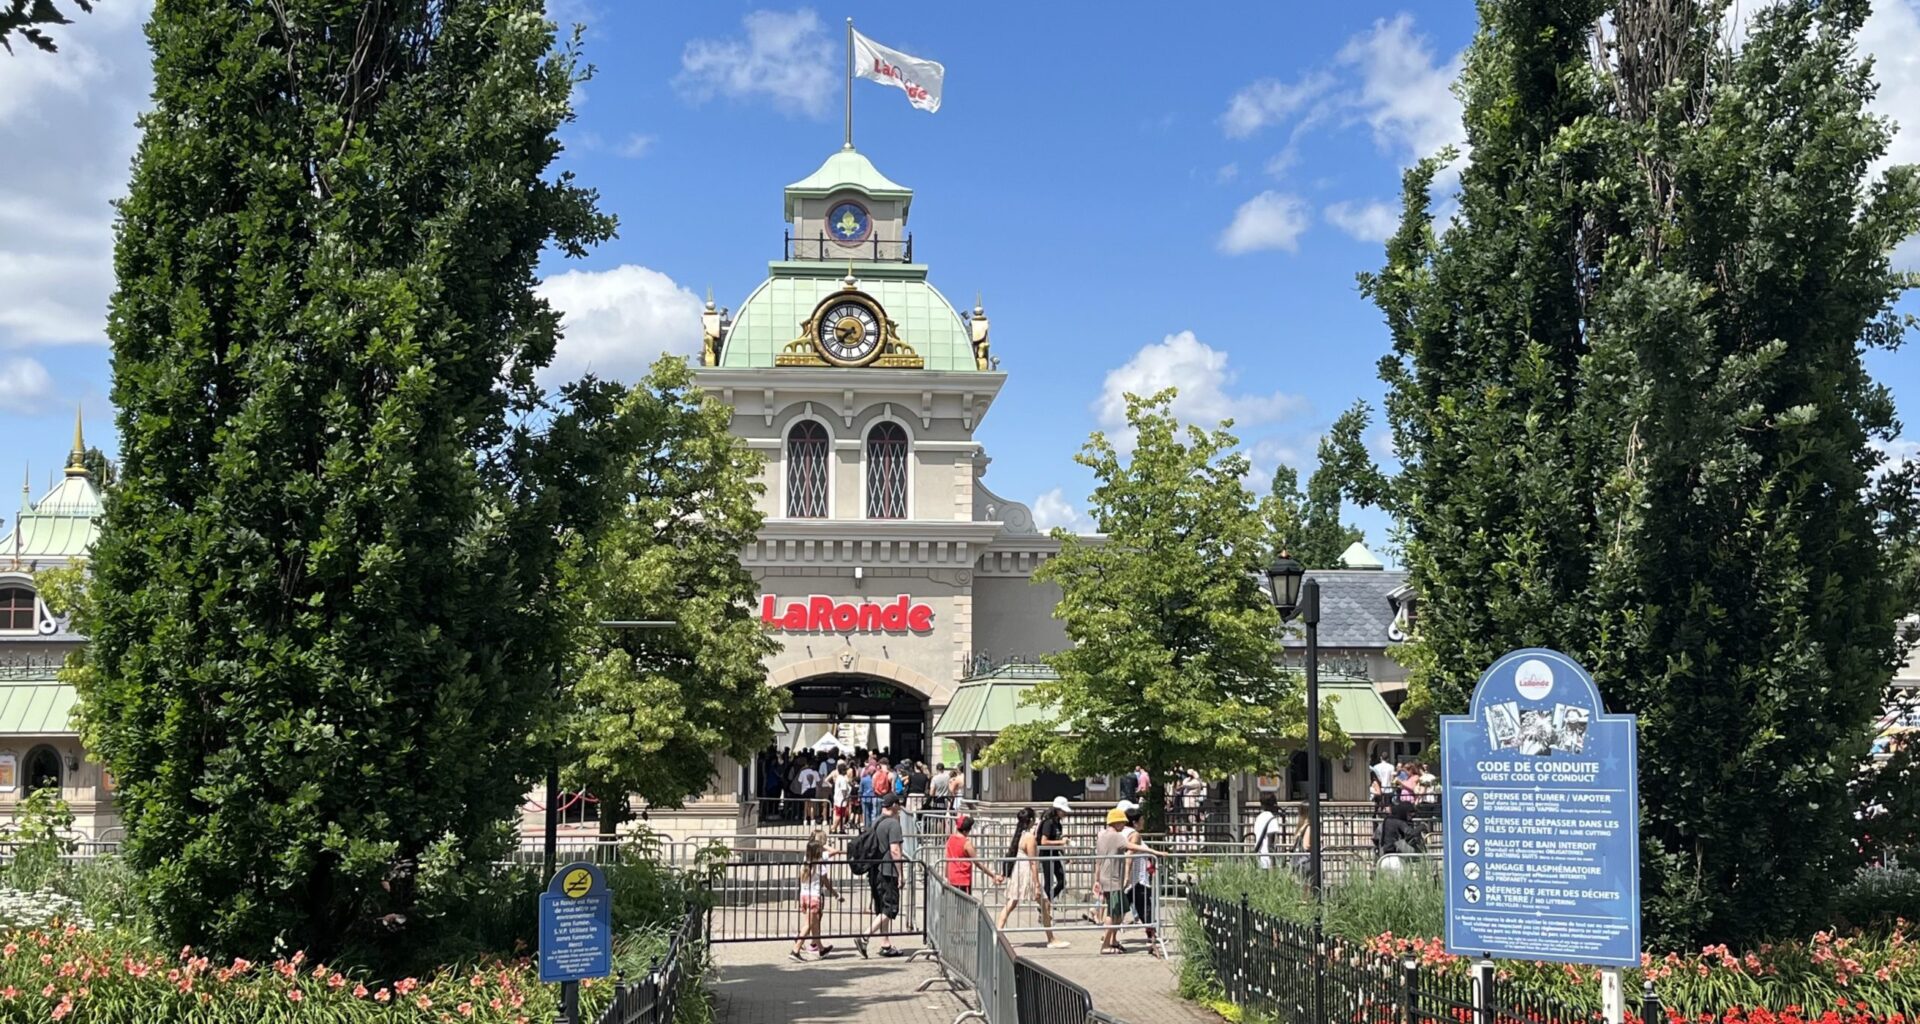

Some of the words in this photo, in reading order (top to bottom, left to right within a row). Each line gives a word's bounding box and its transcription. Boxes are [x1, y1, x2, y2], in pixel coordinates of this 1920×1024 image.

[761, 594, 935, 632] LaRonde
[1476, 761, 1511, 772] CODE
[1514, 762, 1531, 772] DE
[1534, 762, 1599, 773] CONDUITE
[1481, 773, 1508, 781] GUEST
[1538, 774, 1550, 782] OF
[1552, 774, 1596, 782] CONDUCT
[1483, 791, 1520, 800] DÉFENSE
[1536, 794, 1565, 802] FUMER
[1572, 794, 1611, 803] VAPOTER
[1484, 816, 1520, 826] DÉFENSE
[1535, 817, 1576, 827] DÉPASSER
[1578, 820, 1602, 828] DANS
[1508, 826, 1552, 834] D'ATTENTE
[1559, 842, 1597, 850] INTERDIT
[1485, 863, 1524, 871] LANGAGE
[1526, 864, 1601, 875] BLASPHÉMATOIRE
[1485, 884, 1521, 894] DÉFENSE
[1537, 888, 1561, 896] JETER
[1563, 890, 1579, 898] DES
[1582, 888, 1620, 900] DÉCHETS
